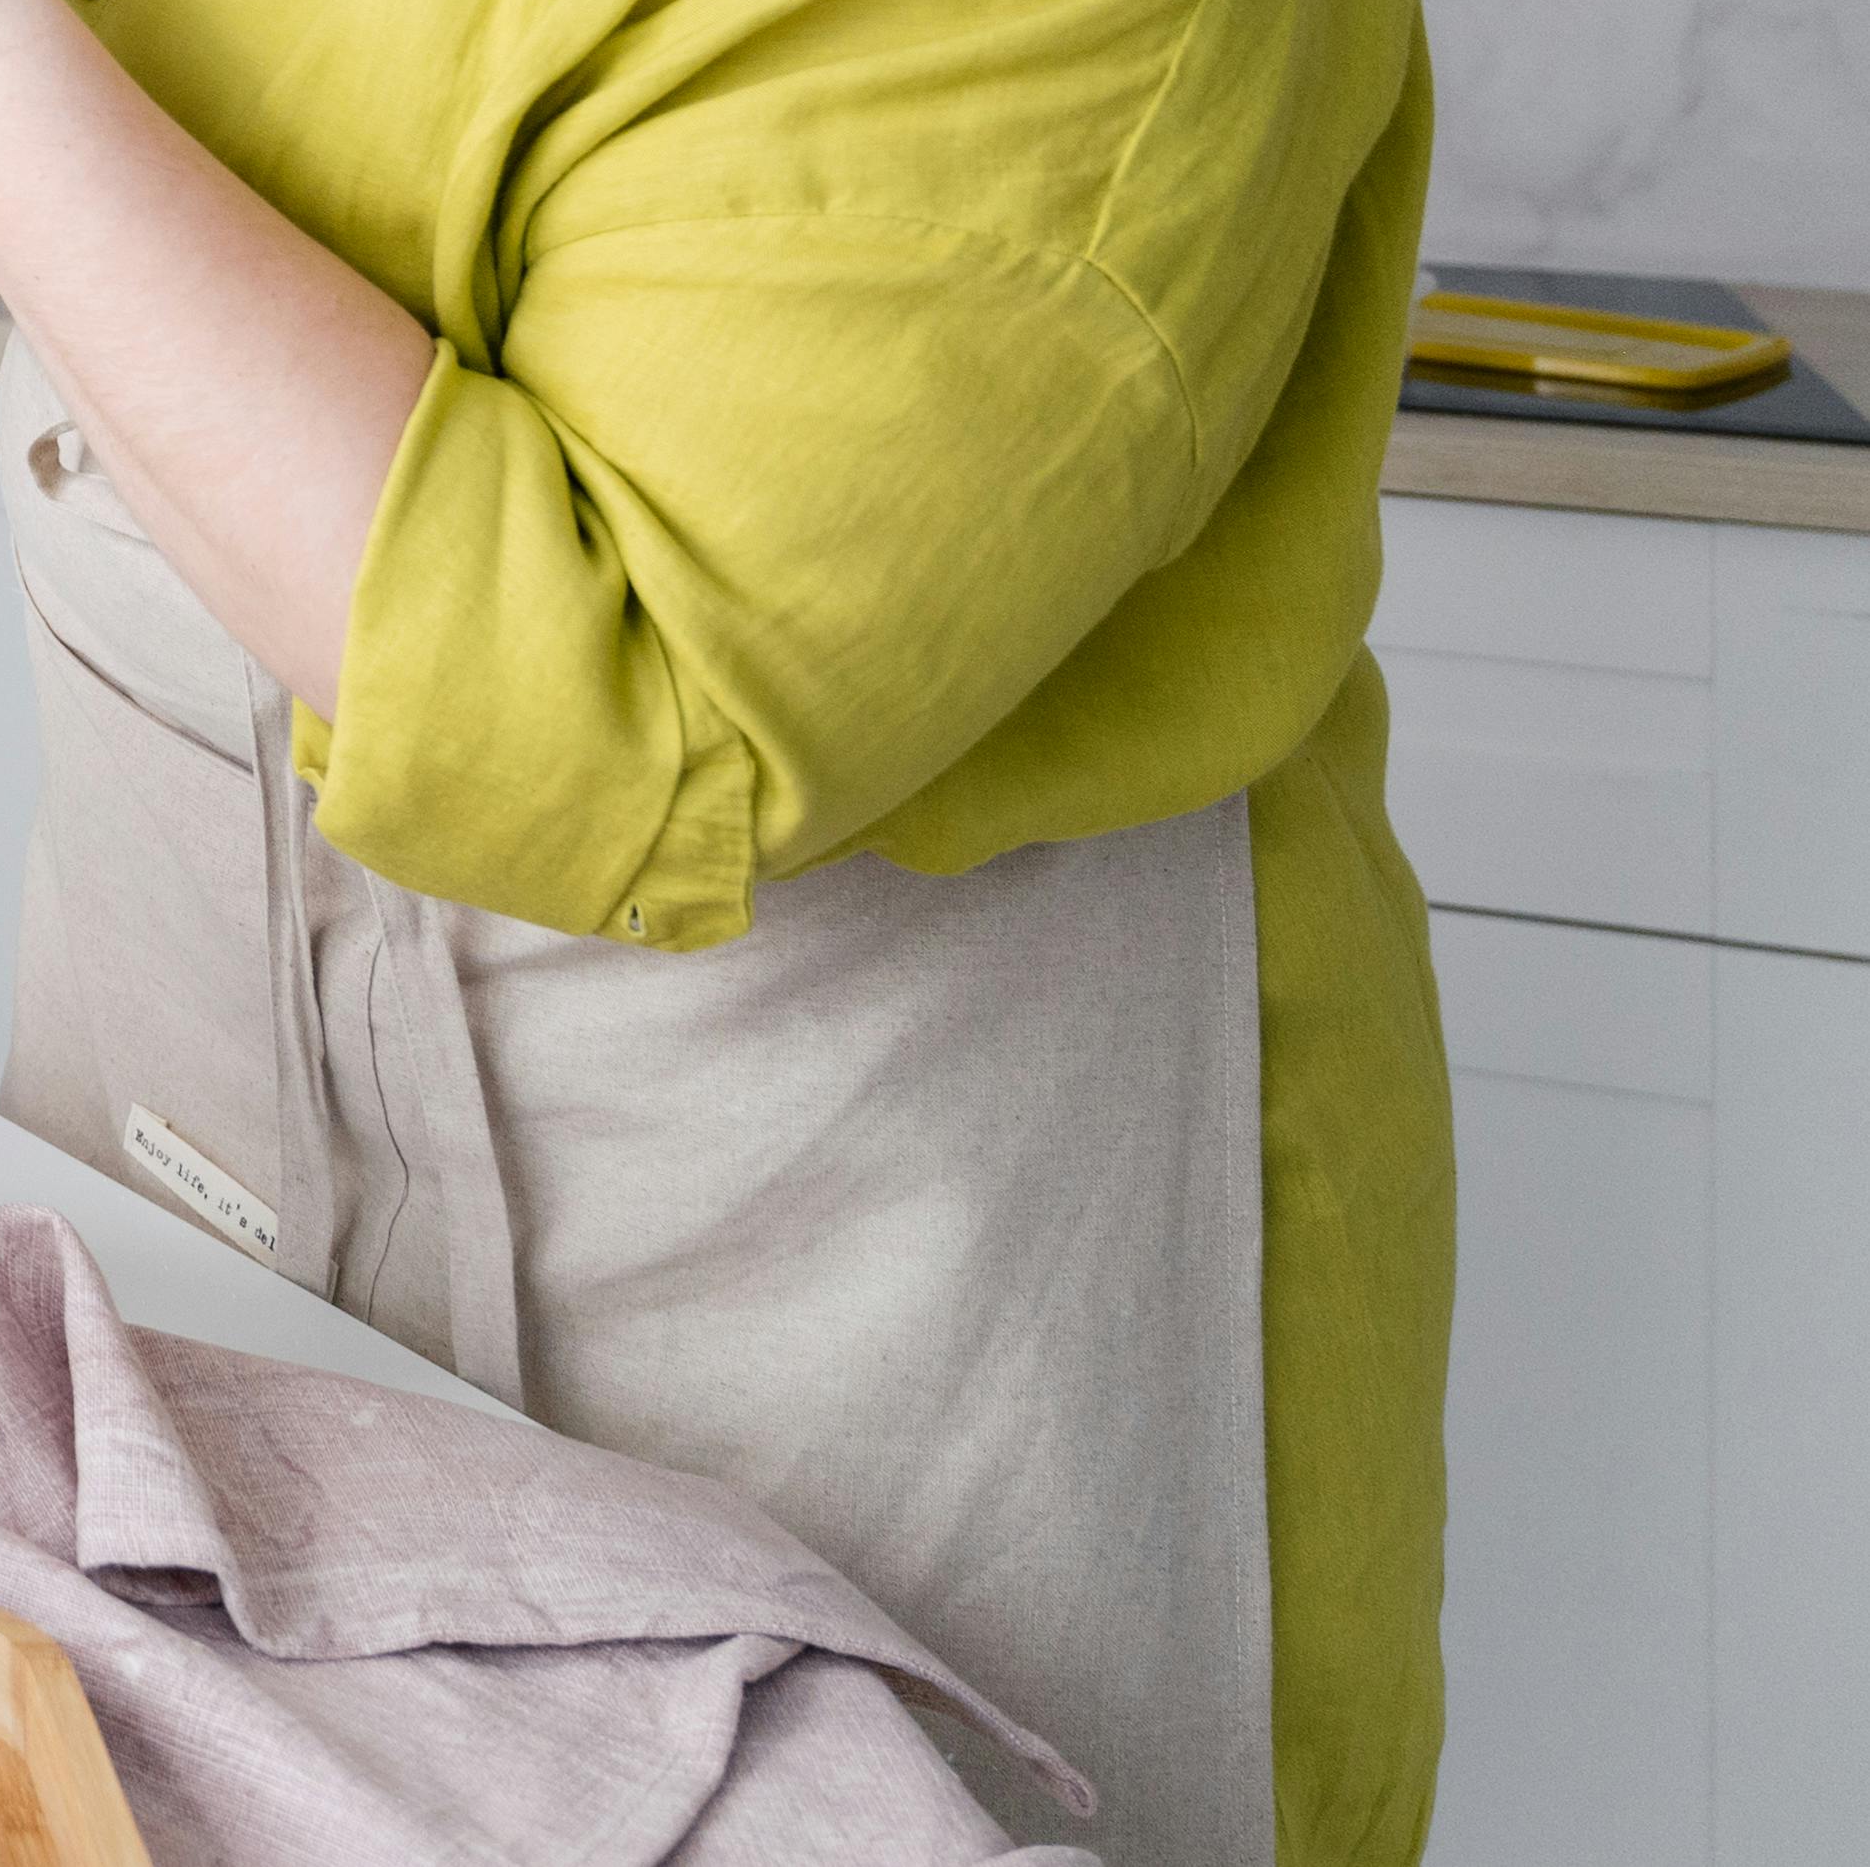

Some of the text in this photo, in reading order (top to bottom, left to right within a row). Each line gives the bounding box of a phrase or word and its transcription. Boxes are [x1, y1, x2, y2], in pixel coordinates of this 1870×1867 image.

[134, 1127, 172, 1167] Enjoy
[177, 1163, 208, 1200] life,
[218, 1197, 248, 1229] it's
